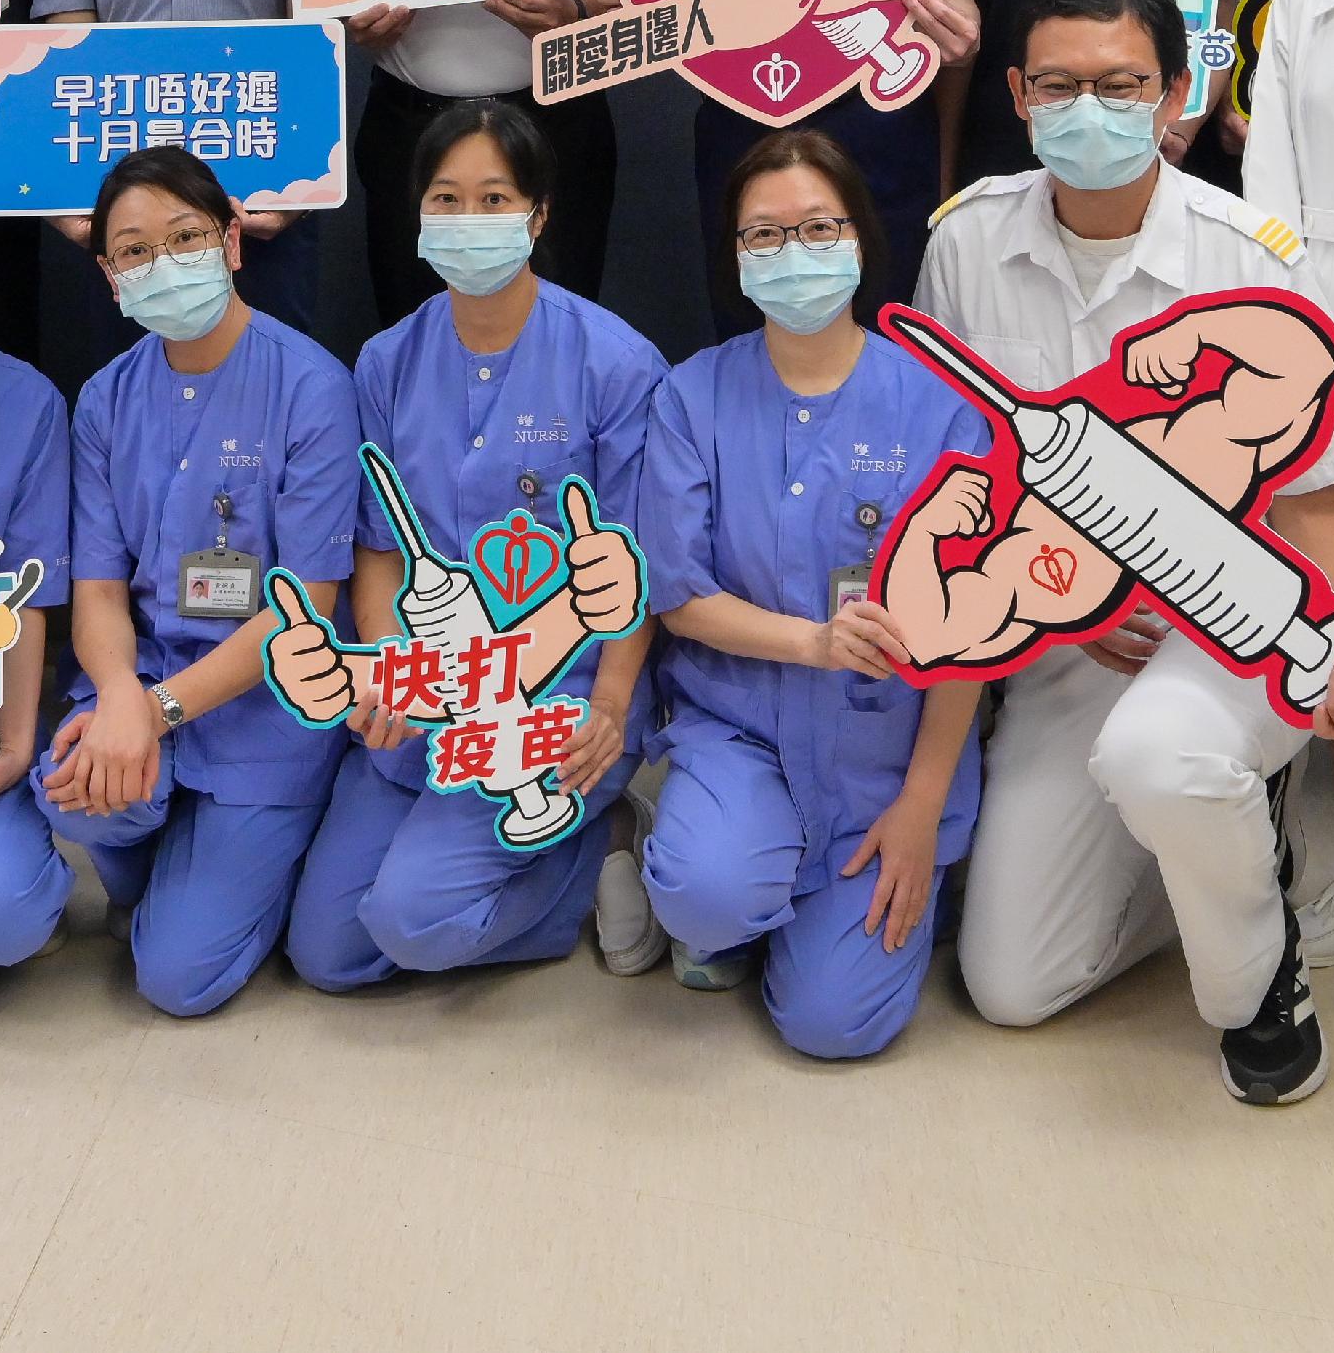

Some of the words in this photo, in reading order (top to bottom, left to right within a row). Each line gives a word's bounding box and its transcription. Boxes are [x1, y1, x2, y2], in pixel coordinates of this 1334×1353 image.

[52, 71, 278, 117] 早打唔好遲
[52, 117, 278, 163] 十月最合時
[515, 412, 567, 427] 護士
[514, 430, 569, 443] NURSE
[852, 442, 907, 458] 護士
[219, 455, 262, 467] NURS
[850, 459, 907, 473] NURSE
[372, 633, 532, 717] 快打
[436, 704, 581, 785] 疫苗
